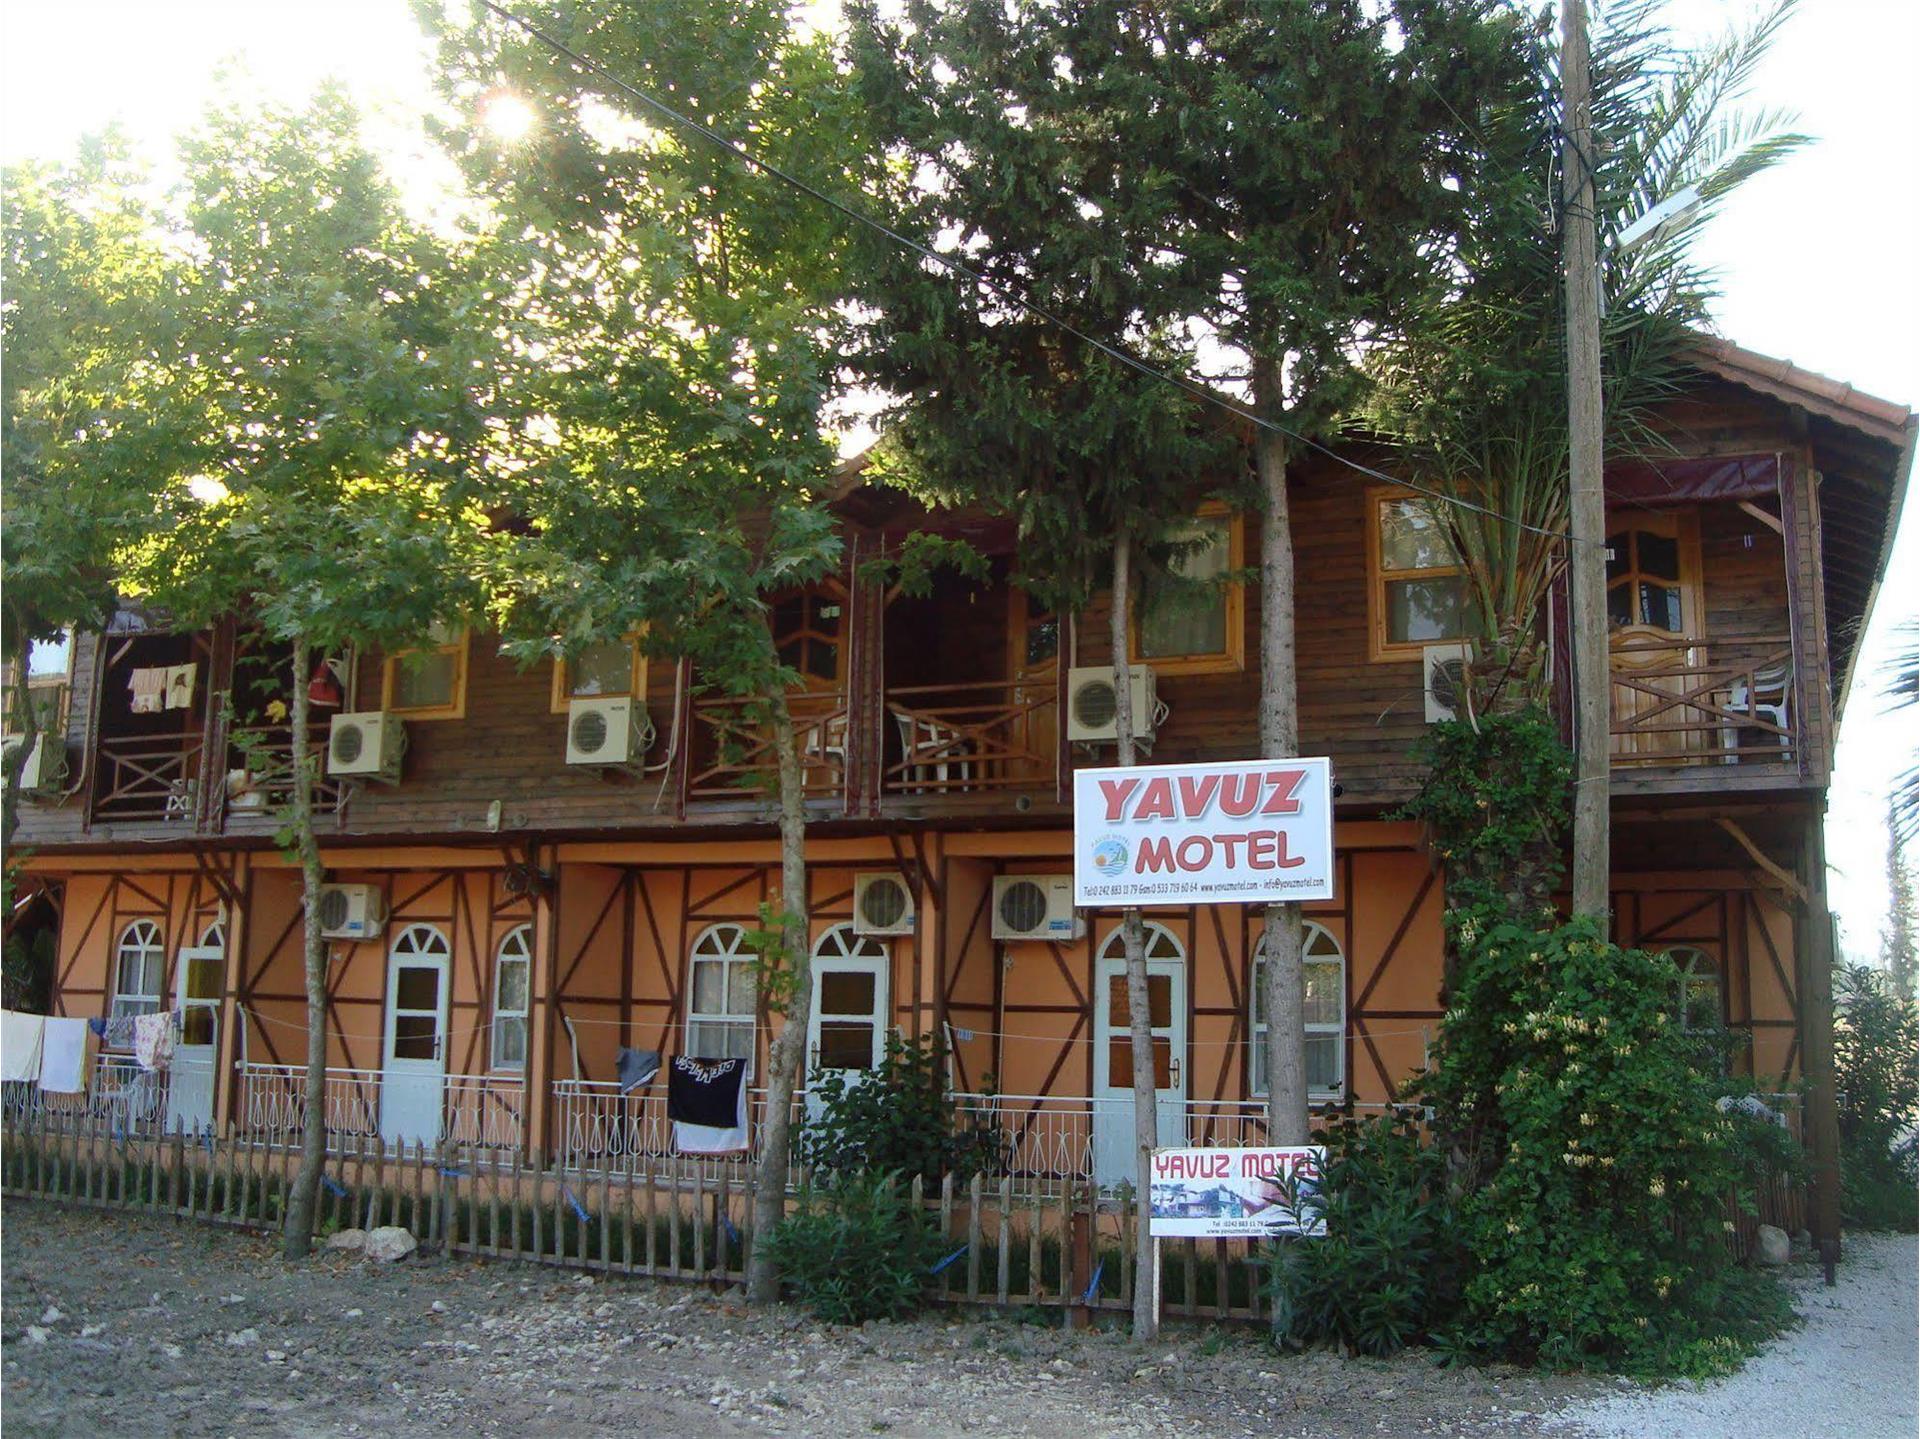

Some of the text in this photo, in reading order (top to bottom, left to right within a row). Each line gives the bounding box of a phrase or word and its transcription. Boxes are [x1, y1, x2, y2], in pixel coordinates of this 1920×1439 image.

[1098, 770, 1306, 822] YAVUZ
[1135, 830, 1306, 875] MOTEL
[1098, 886, 1110, 896] 242
[1111, 885, 1122, 896] 883
[1130, 884, 1138, 895] 79
[1157, 883, 1169, 894] 533
[1169, 882, 1180, 894] 719
[1181, 882, 1190, 893] 60
[1190, 881, 1198, 893] 64
[1201, 880, 1258, 894] www.yavuzmotel.com
[1263, 878, 1325, 892] info@yavuzmotel.com
[1155, 1153, 1320, 1179] YAVUZ MOTEL
